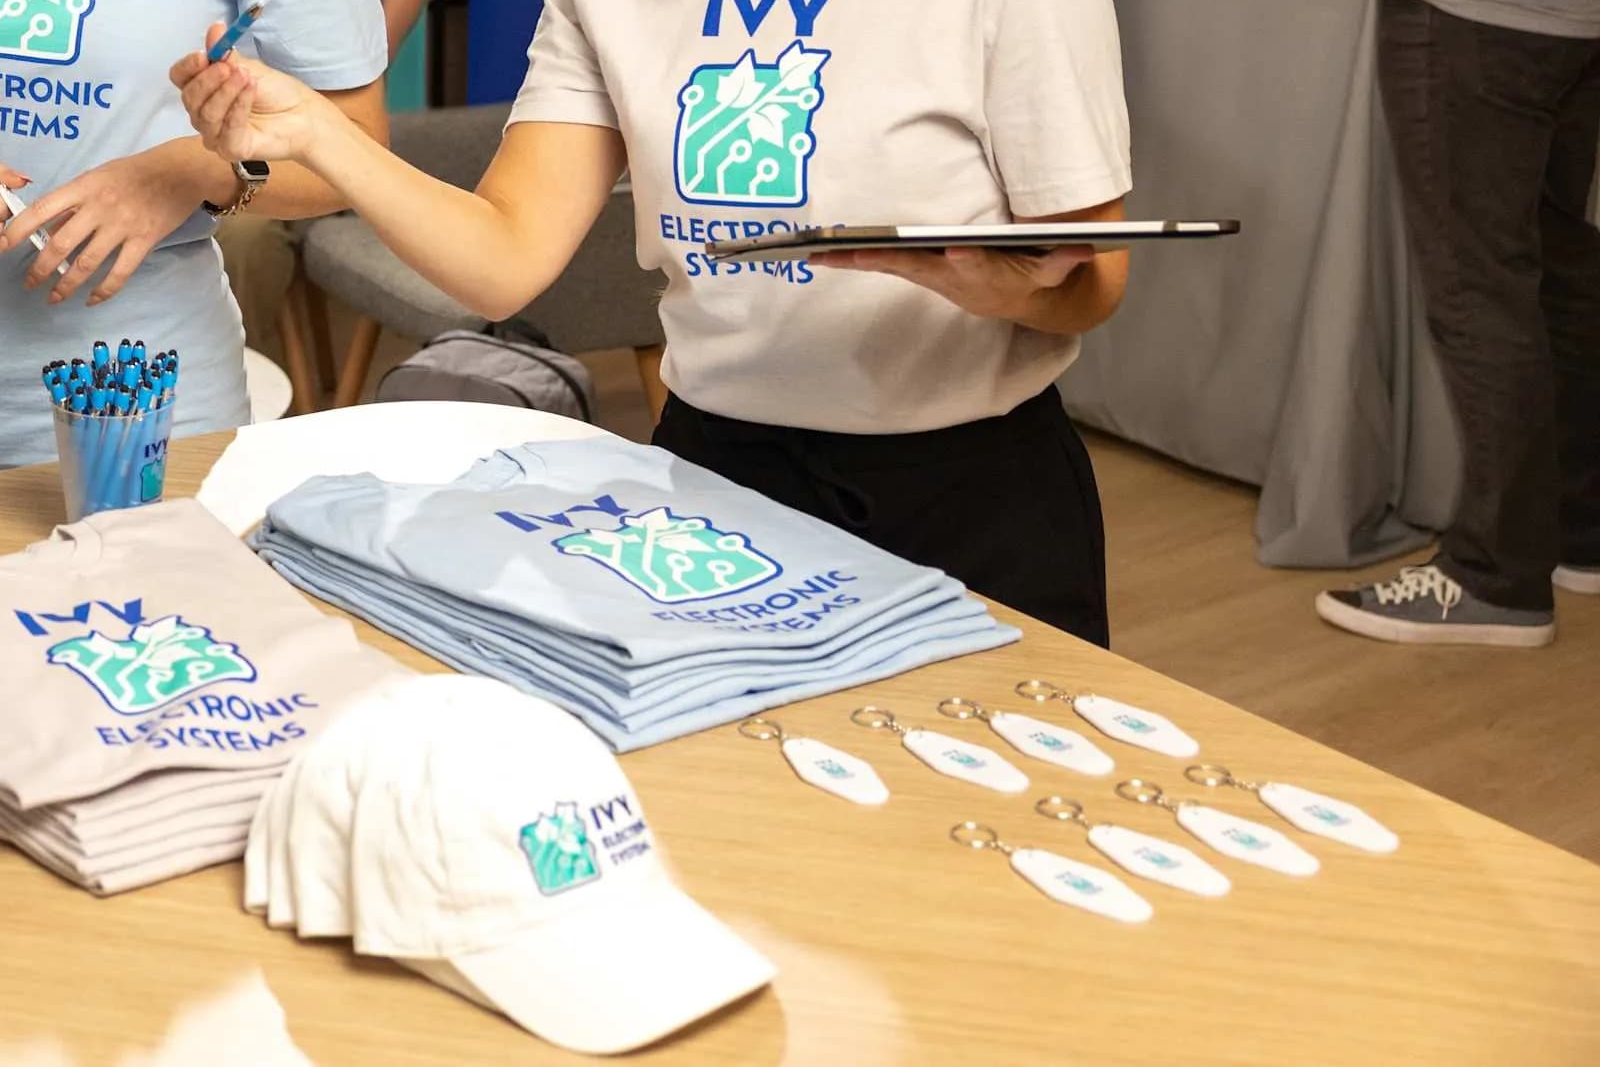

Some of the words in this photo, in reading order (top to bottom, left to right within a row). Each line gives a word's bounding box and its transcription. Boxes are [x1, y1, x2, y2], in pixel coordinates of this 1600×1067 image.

[495, 494, 630, 533] IVY
[651, 570, 858, 624] ELECTRONIC
[14, 598, 147, 636] IVY
[146, 722, 307, 752] SYSTEMS
[591, 795, 632, 830] IVY
